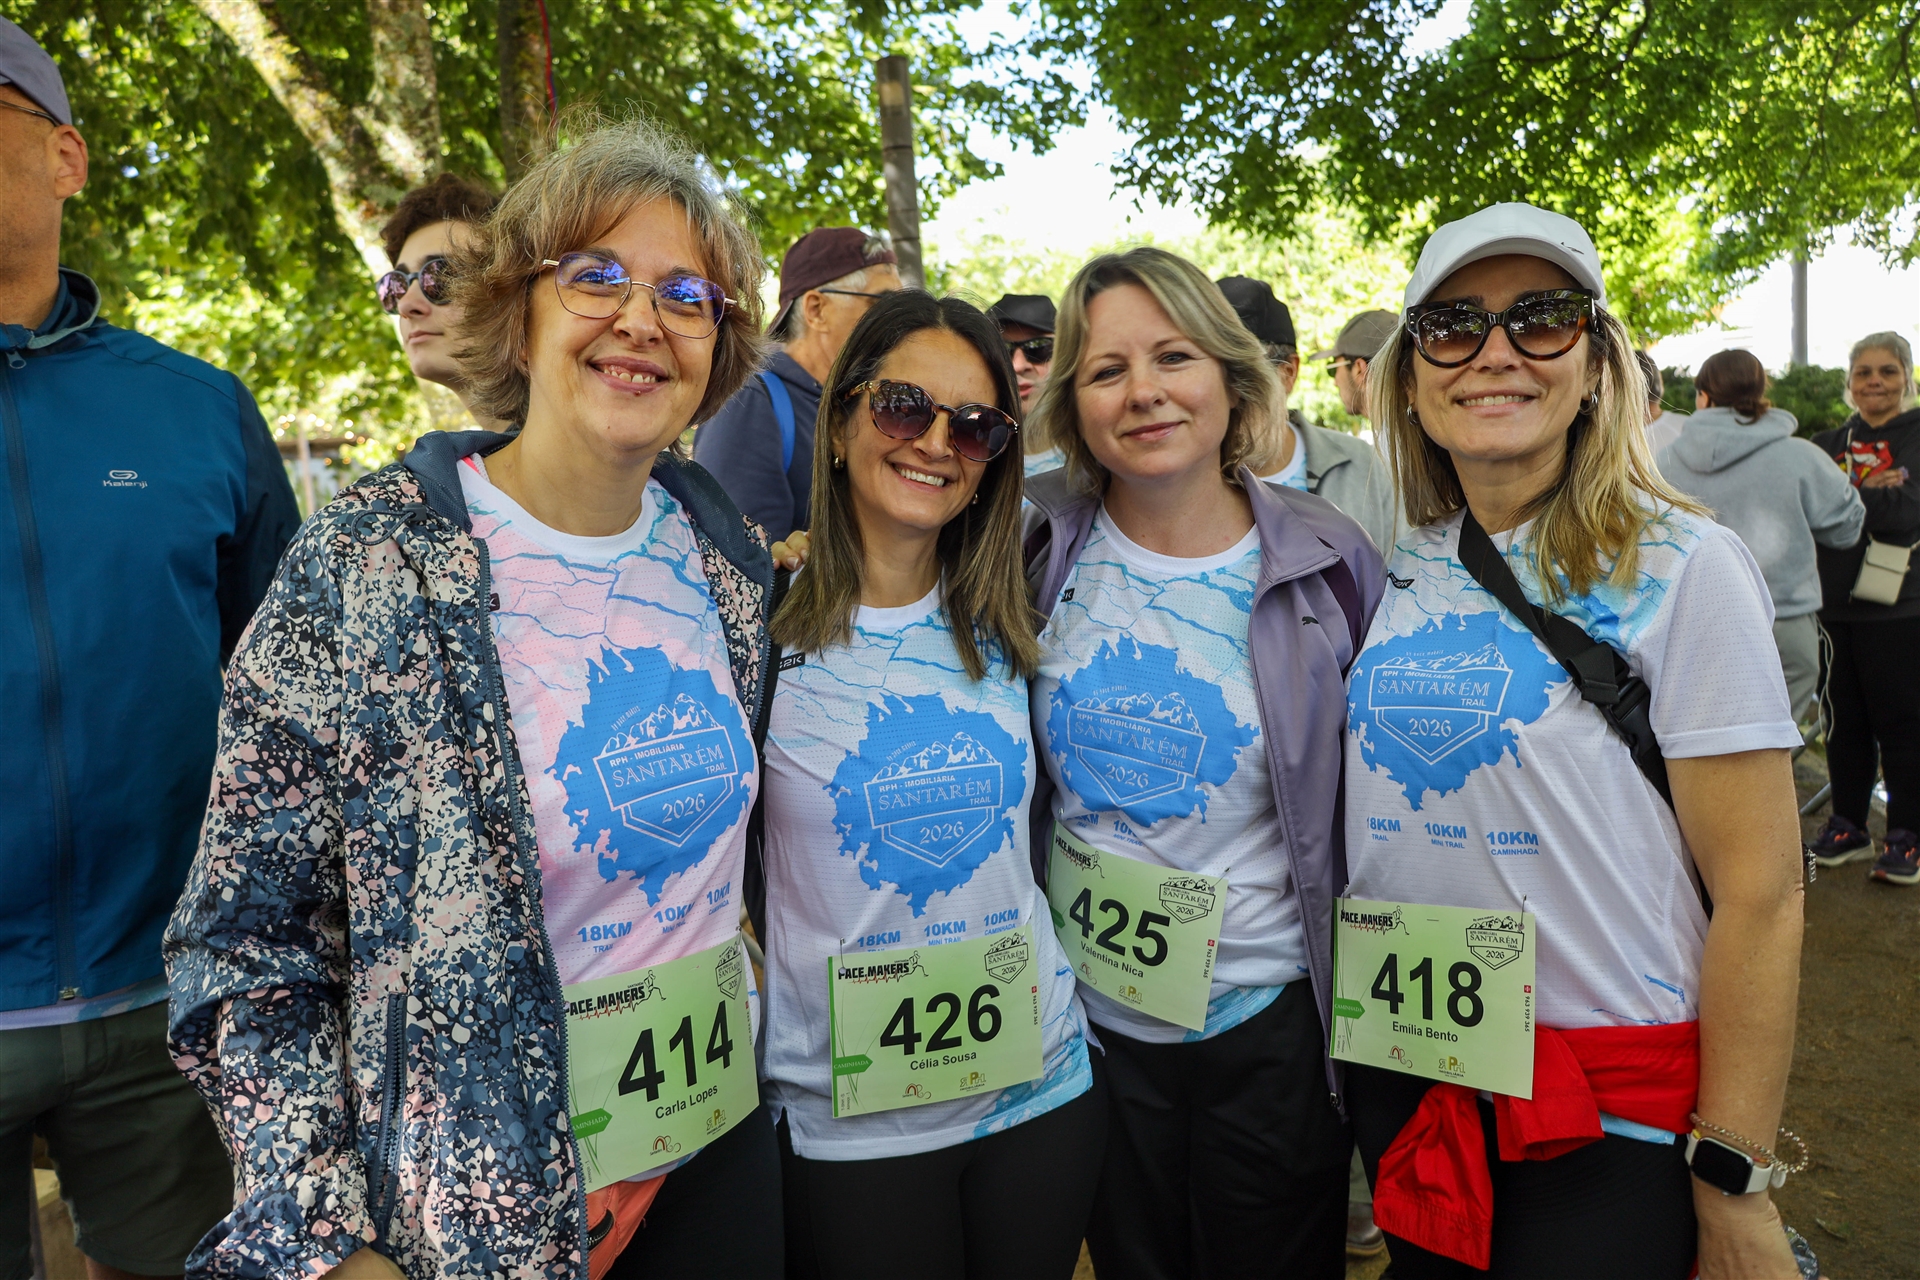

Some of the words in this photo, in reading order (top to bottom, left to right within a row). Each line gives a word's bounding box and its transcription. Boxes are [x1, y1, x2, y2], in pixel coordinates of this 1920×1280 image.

[103, 480, 148, 488] Kalenji
[1378, 678, 1490, 697] SANTARÉM
[1461, 698, 1486, 706] TRAIL
[1077, 713, 1093, 721] RPH
[1408, 718, 1452, 738] 2026
[1075, 722, 1188, 759] SANTARÉM
[609, 756, 629, 767] RPH
[612, 744, 725, 788] SANTARÉM
[705, 762, 727, 775] TRAIL
[1160, 756, 1185, 768] TRAIL
[1105, 763, 1148, 788] 2026
[878, 778, 992, 810] SANTARÉM
[879, 784, 898, 792] RPH
[660, 792, 706, 824] 2026
[970, 796, 991, 806] TRAIL
[920, 821, 964, 844] 2026
[1424, 822, 1467, 839] 10KM
[1486, 832, 1539, 846] 10KM
[1163, 890, 1209, 905] SANTARÉM
[1176, 906, 1194, 916] 2026
[577, 921, 632, 944] 18KM
[857, 931, 901, 947] 18KM
[924, 920, 966, 937] 10KM
[984, 908, 1019, 927] 10KM
[1069, 888, 1170, 966] 425
[1470, 934, 1518, 944] SANTARÉM
[988, 949, 1025, 964] SANTARÉM
[1081, 941, 1119, 968] Valentina
[1122, 964, 1144, 978] Nica
[1486, 950, 1505, 959] 2026
[1371, 953, 1484, 1028] 418
[565, 986, 645, 1016] ACE.MAKERS
[880, 984, 1002, 1055] 426
[1392, 1021, 1422, 1036] Emília
[1426, 1027, 1458, 1043] Bento
[617, 1000, 734, 1102] 414
[834, 1059, 869, 1069] CAMINHADA
[910, 1058, 939, 1071] Célia
[942, 1052, 977, 1065] Sousa
[656, 1100, 687, 1120] Carla
[690, 1084, 718, 1108] Lopes
[572, 1116, 608, 1131] AMINHADA
